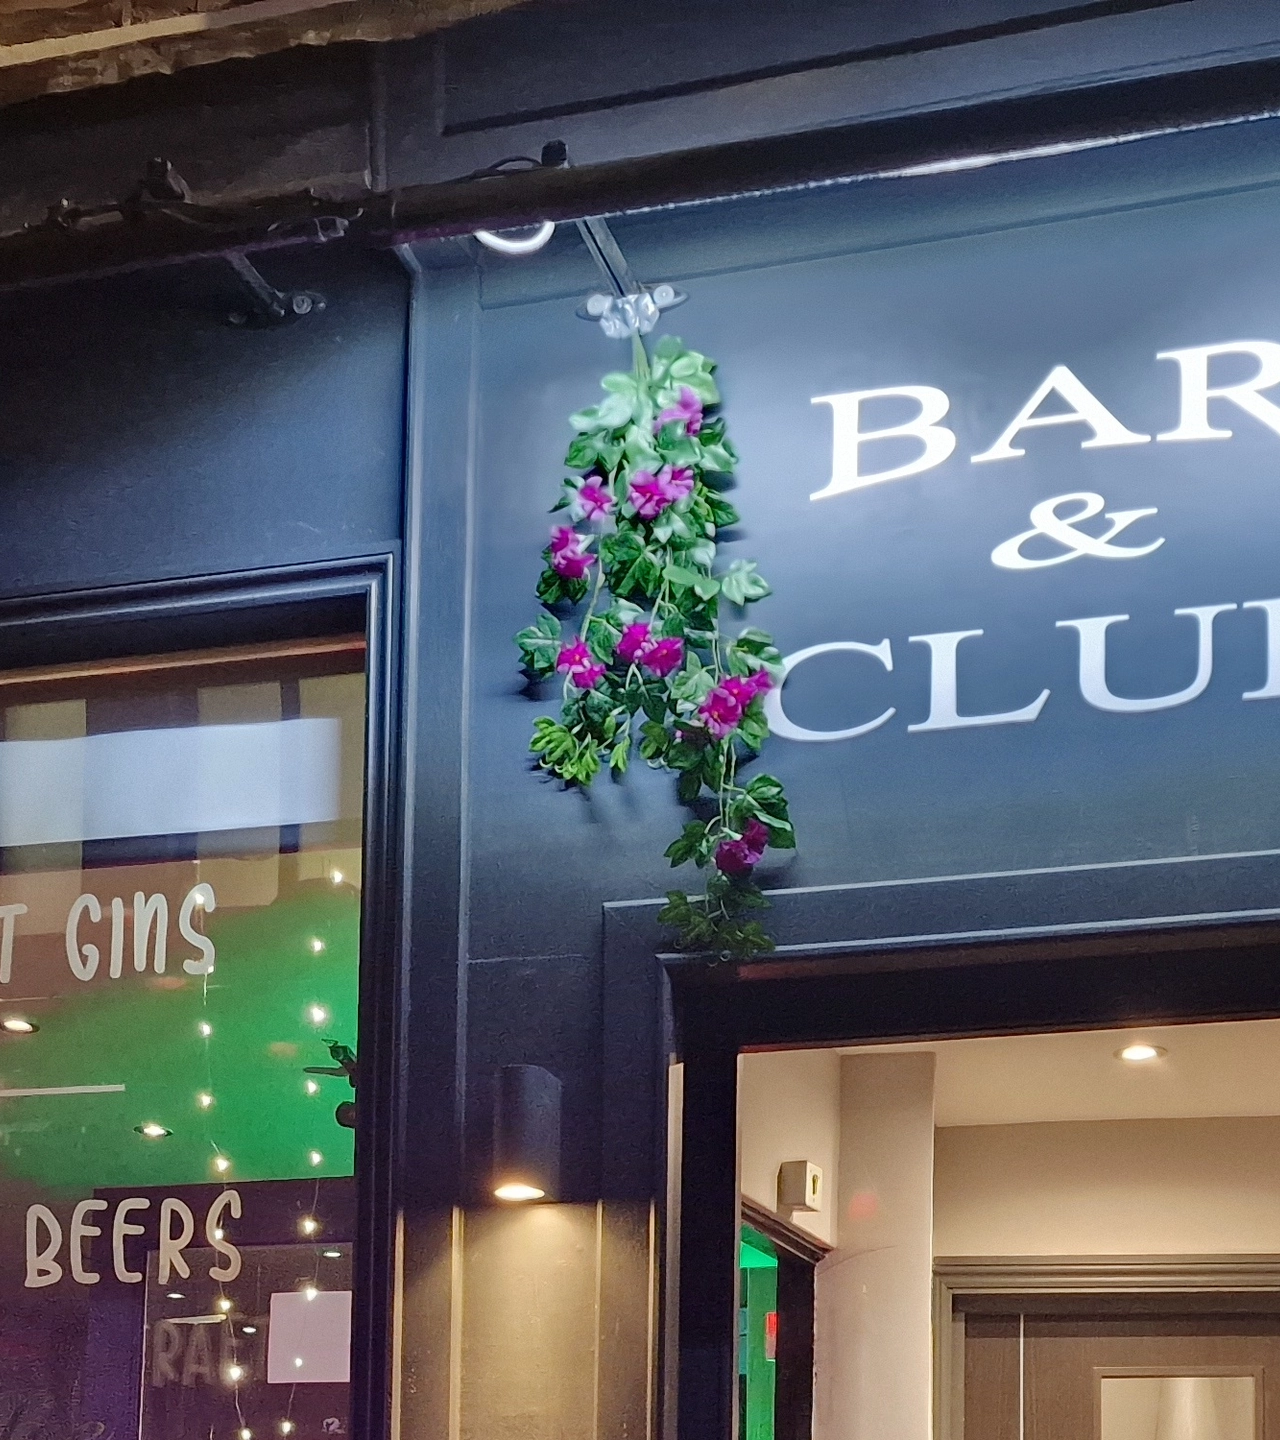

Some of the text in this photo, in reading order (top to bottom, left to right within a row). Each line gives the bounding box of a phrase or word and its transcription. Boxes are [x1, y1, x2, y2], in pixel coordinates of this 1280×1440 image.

[990, 491, 1166, 570] &
[66, 883, 217, 982] GINS
[23, 1189, 243, 1289] BEERS
